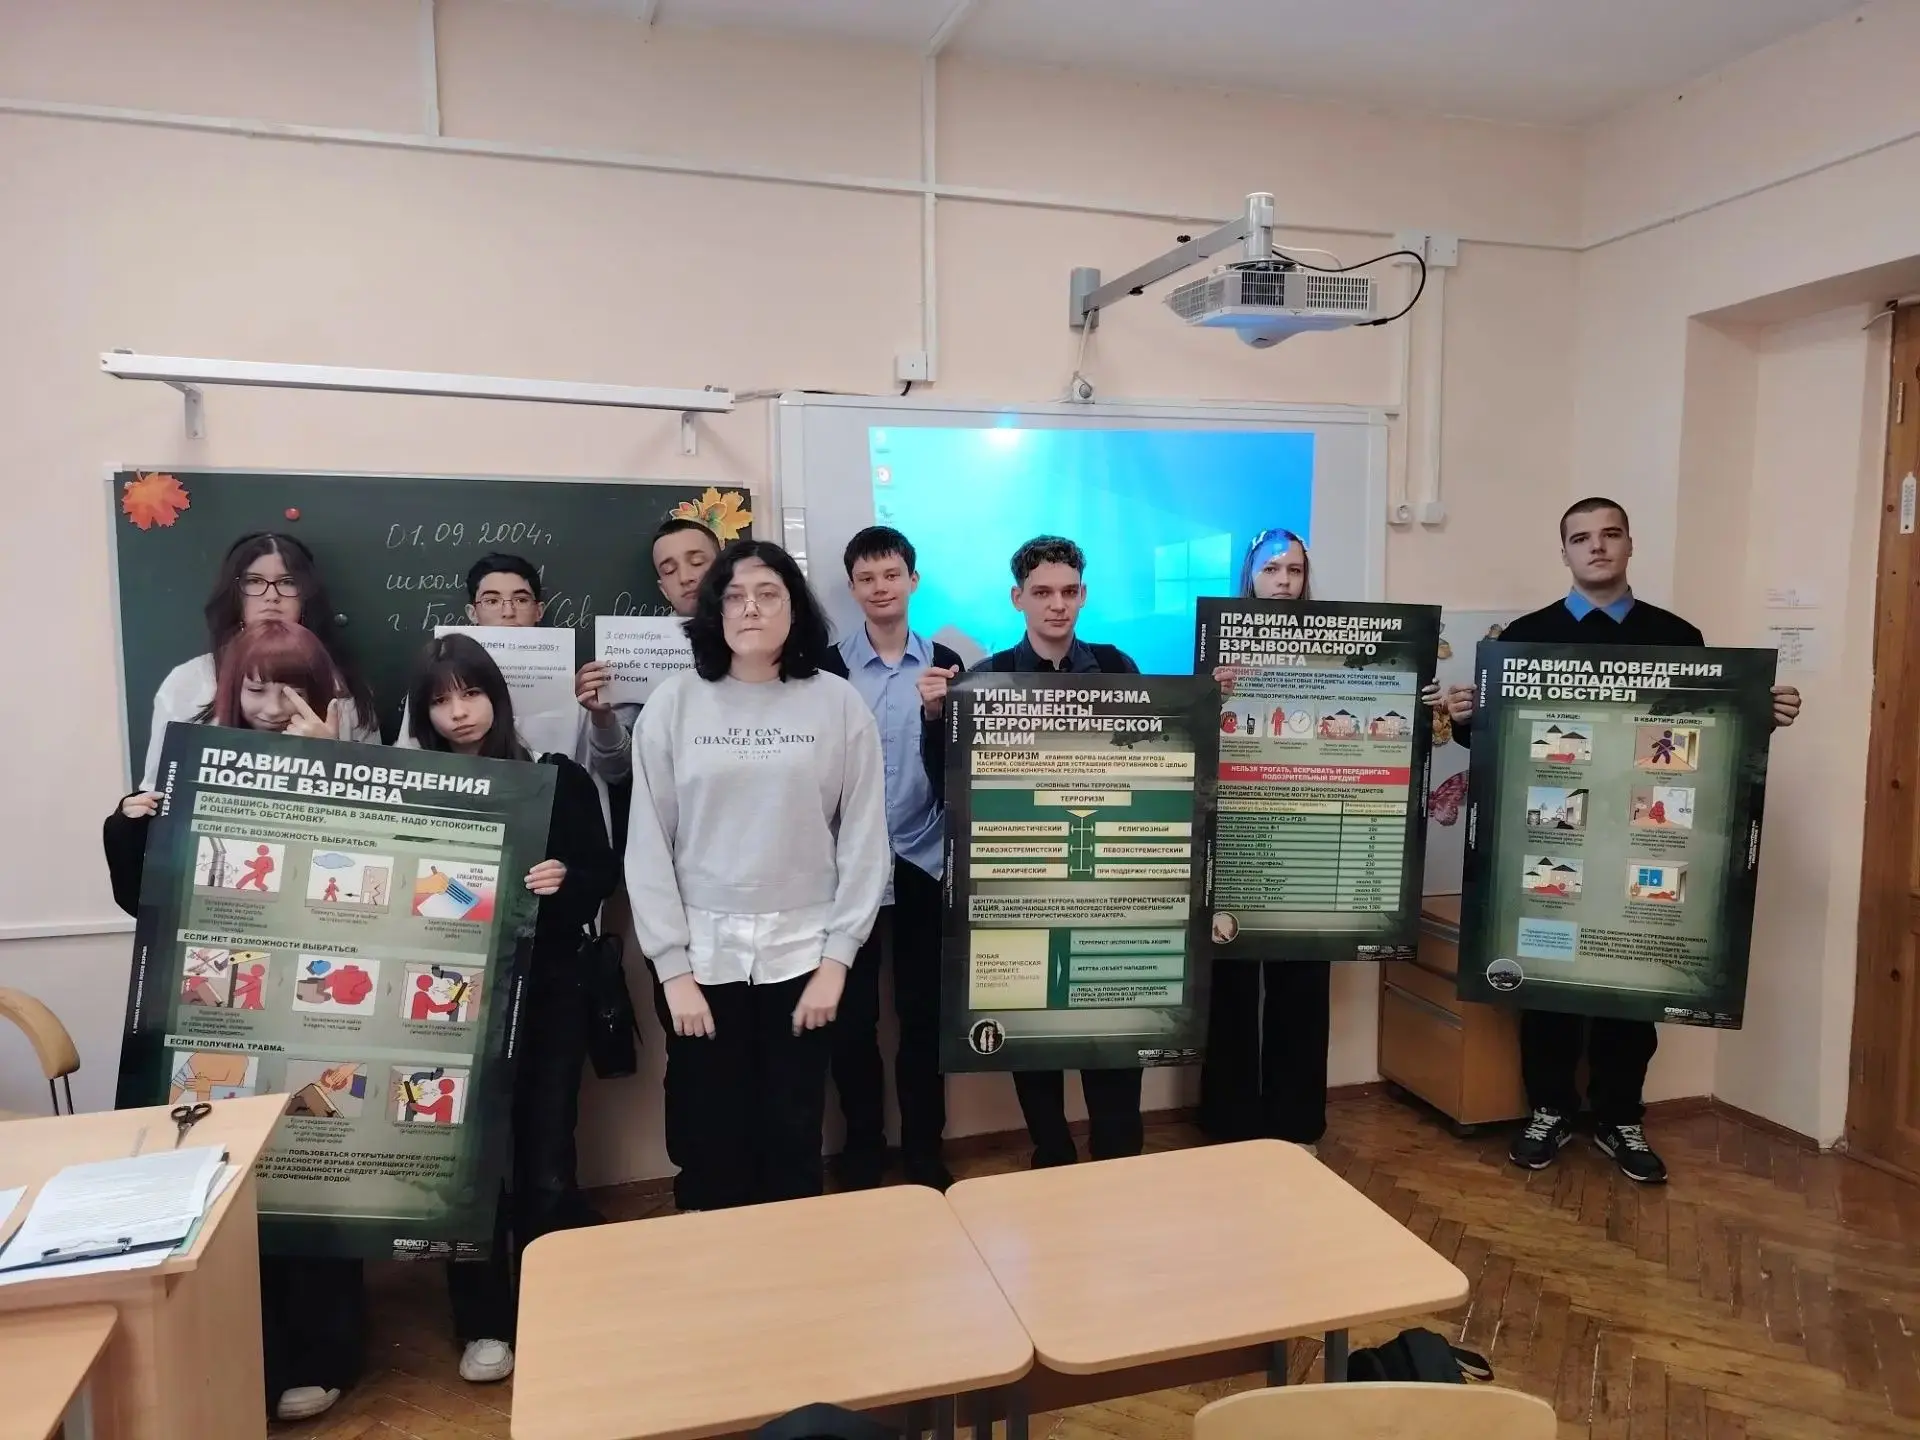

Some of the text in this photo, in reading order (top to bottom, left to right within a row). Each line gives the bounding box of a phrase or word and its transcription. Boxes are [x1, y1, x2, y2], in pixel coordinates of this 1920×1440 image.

[386, 571, 468, 591] школ
[1220, 612, 1403, 630] ПРАВИЛА ПОВЕДЕНИЯ
[605, 630, 662, 642] 3 сентября
[1219, 626, 1383, 642] ПРИ ОБНАРУЖЕНИИ
[604, 645, 632, 657] День
[1219, 639, 1377, 656] ВЗРЫВООПАСНОГО
[1218, 652, 1308, 667] ПРЕДМЕТА
[1503, 658, 1723, 678] ПРАВИЛА ПОВЕДЕНИЯ
[614, 673, 649, 683] России
[1502, 671, 1671, 689] ПРИ ПОПАДАНИИ
[972, 688, 1151, 704] ТИПЫ ТЕРРОРИЗМА
[1479, 668, 1488, 708] ТЕРРОРИЗМ
[1501, 685, 1638, 702] ПОД ОБСТРЕЛ
[973, 703, 1094, 717] И ЭЛЕМЕНТЫ
[727, 727, 783, 737] IF I CAN
[972, 716, 1163, 732] ТЕРРОРИСТИЧЕСКОЙ
[694, 734, 816, 746] CHANGE MY MIND
[972, 731, 1035, 747] АКЦИИ
[977, 751, 1040, 760] ТЕРРОРИЗМ
[201, 747, 492, 796] ПРАВИЛА ПОВЕДЕНИЯ
[1262, 773, 1329, 781] ПОДОЗРИТЕЛЬНЫЙ
[160, 761, 179, 817] ТЕРРОРИЗМ
[199, 766, 403, 804] ПОСЛЕ ВЗРЫВА
[201, 795, 498, 833] ОКАЗАВШИСЬ ПОСЛЕ ВЗРЫВА В ЗАВАЛЕ, НАДО УСПОКОИТЬСЯ
[209, 805, 258, 818] ОЦЕНИТЬ
[259, 810, 328, 825] ОБСТАНОВКУ.
[197, 823, 378, 848] ЕСЛИ ЕСТЬ ВОЗМОЖНОСТЬ ВЫБРАТЬСЯ:
[183, 932, 359, 953] ЕСЛИ НЕТ ВОЗМОЖНОСТИ ВЫБРАТЬСЯ:
[169, 1037, 285, 1052] ЕСЛИ ПОЛУЧЕНА ТРАВМА:
[288, 1148, 349, 1158] ПОЛЬЗОВАТЬСЯ
[271, 1173, 323, 1181] СМОЧЕННЫМ
[272, 1164, 342, 1174] ЗАГАЗОВАННОСТИ
[379, 1169, 420, 1177] ЗАЩИТИТЬ
